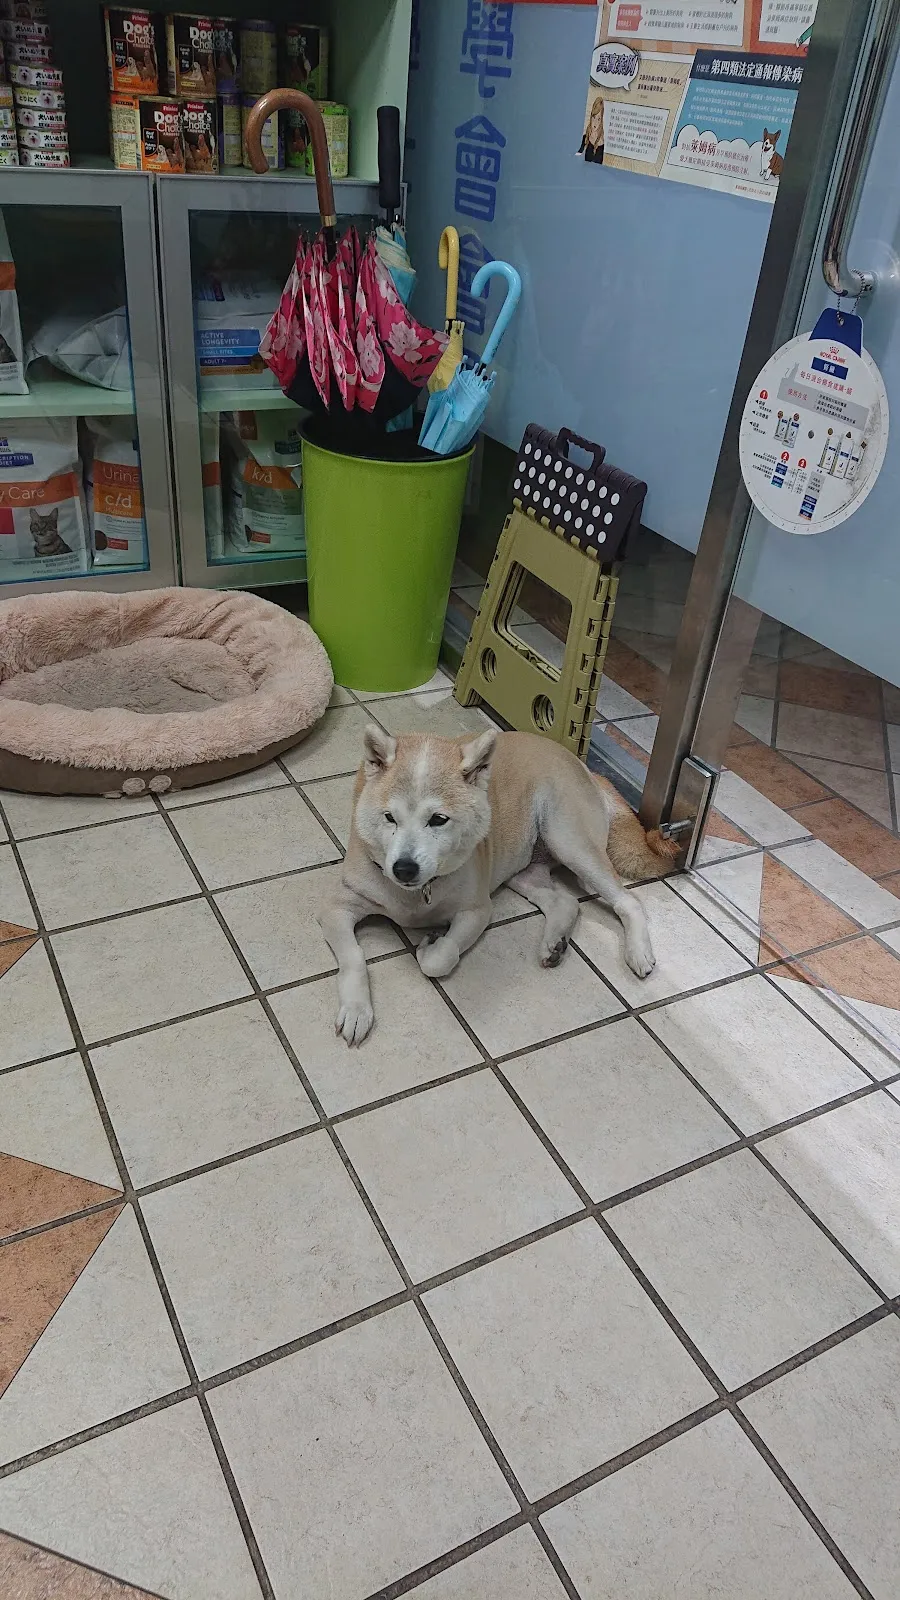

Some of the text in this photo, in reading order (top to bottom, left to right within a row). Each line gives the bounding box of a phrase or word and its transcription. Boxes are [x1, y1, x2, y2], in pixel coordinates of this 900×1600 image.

[123, 20, 155, 38] Dog's
[126, 32, 155, 46] Choice
[597, 52, 638, 77] 真實案例
[710, 59, 804, 84] 第四類法定通報傳染病
[690, 138, 717, 157] 萊姆病
[252, 467, 273, 484] k/d
[9, 486, 45, 500] Care
[105, 494, 132, 509] c/d
